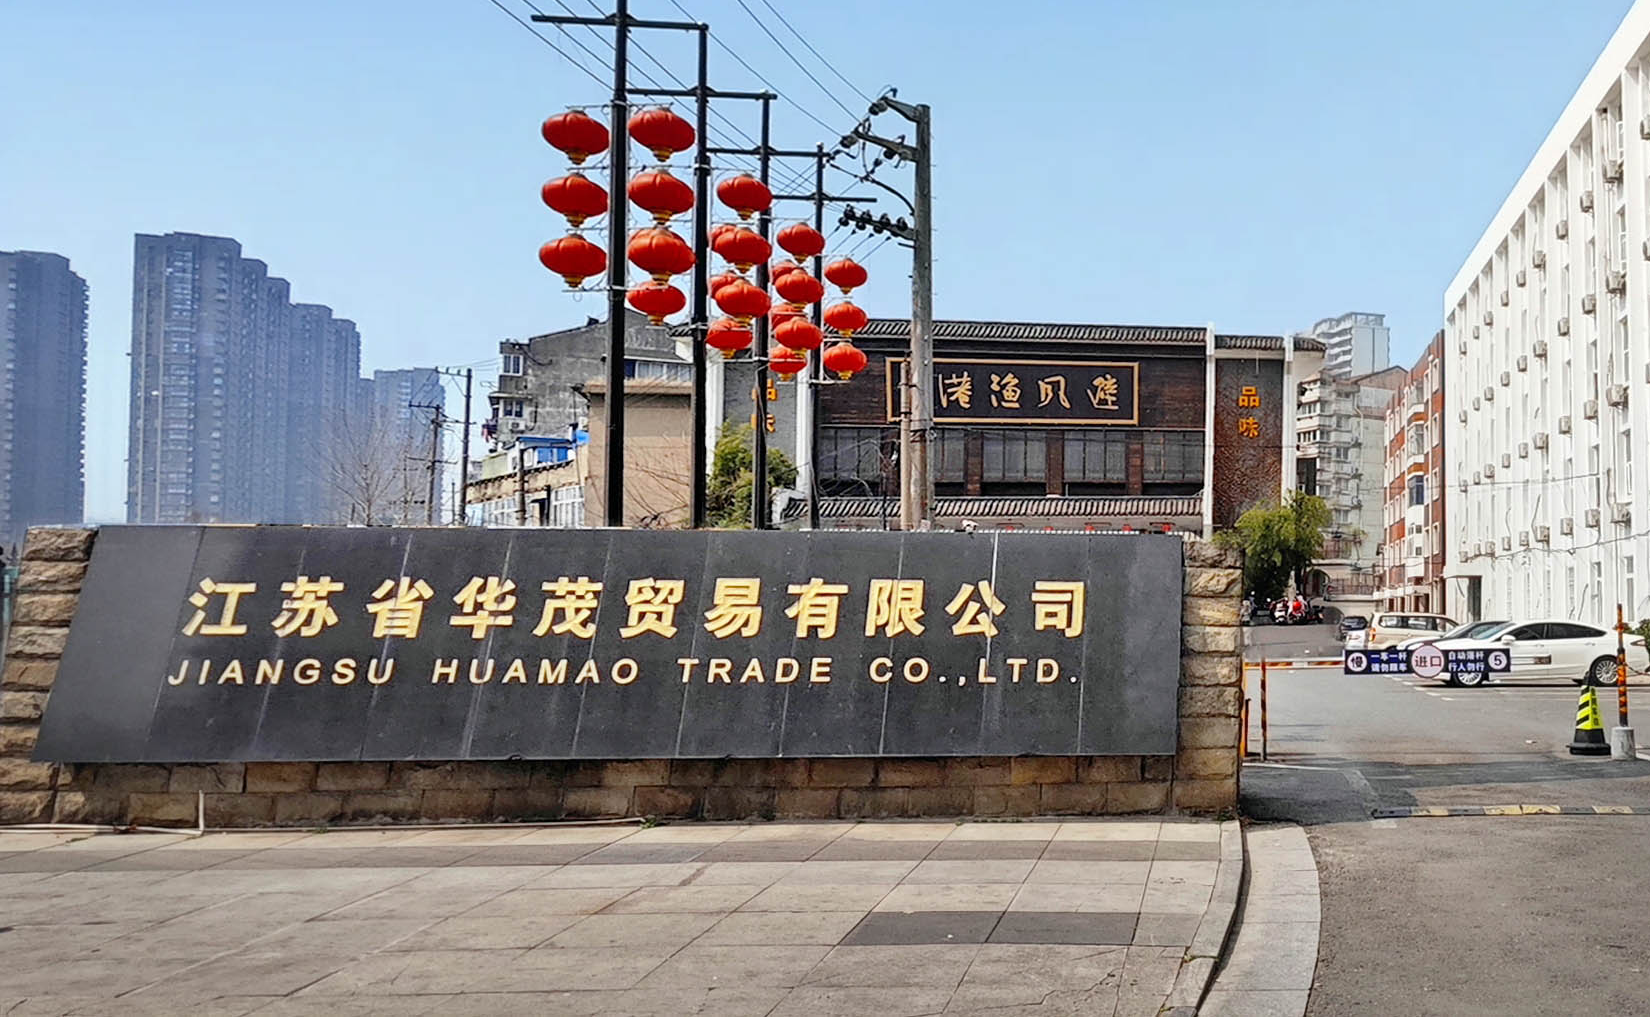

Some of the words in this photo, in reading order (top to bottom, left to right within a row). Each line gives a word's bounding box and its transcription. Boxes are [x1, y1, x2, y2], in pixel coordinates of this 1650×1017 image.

[1237, 386, 1260, 439] 品味
[181, 575, 1086, 638] 江苏省华茂贸易有限公司
[1371, 651, 1408, 661] 一车一杆
[1415, 655, 1442, 668] 进口
[1494, 654, 1503, 668] 5
[168, 658, 394, 686] JIANGSU
[432, 658, 638, 685] HUAMAO
[677, 658, 833, 683] TRADE
[869, 657, 1080, 686] CO.,LTD.
[1448, 662, 1485, 672] 行人勿行
